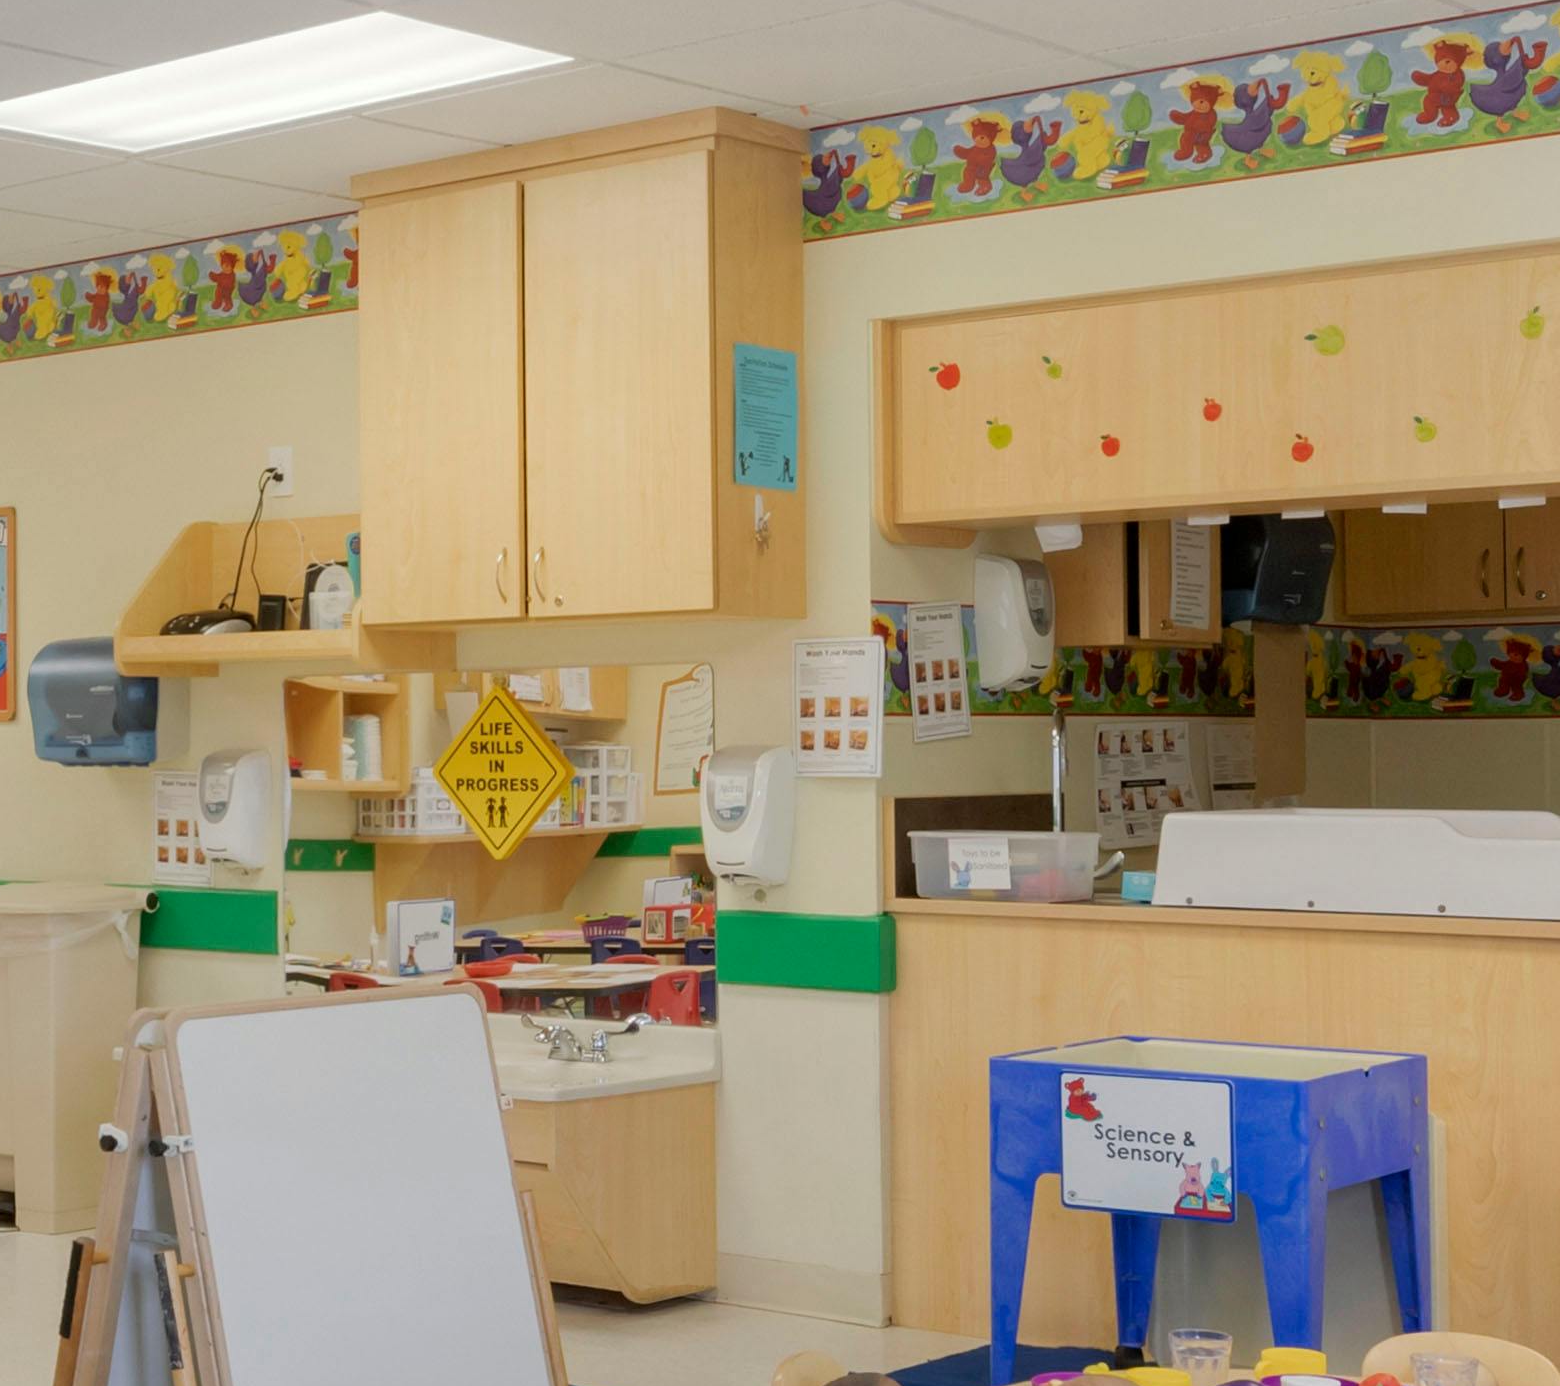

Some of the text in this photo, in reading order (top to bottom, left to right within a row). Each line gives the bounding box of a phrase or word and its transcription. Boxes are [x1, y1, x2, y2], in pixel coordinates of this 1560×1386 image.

[480, 723, 513, 736] LIFE
[470, 741, 524, 755] SKILLS
[489, 760, 505, 773] IN
[456, 778, 539, 792] PROGRESS
[990, 849, 1001, 857] be
[1094, 1124, 1196, 1147] Science &
[1106, 1143, 1184, 1168] Sensory
